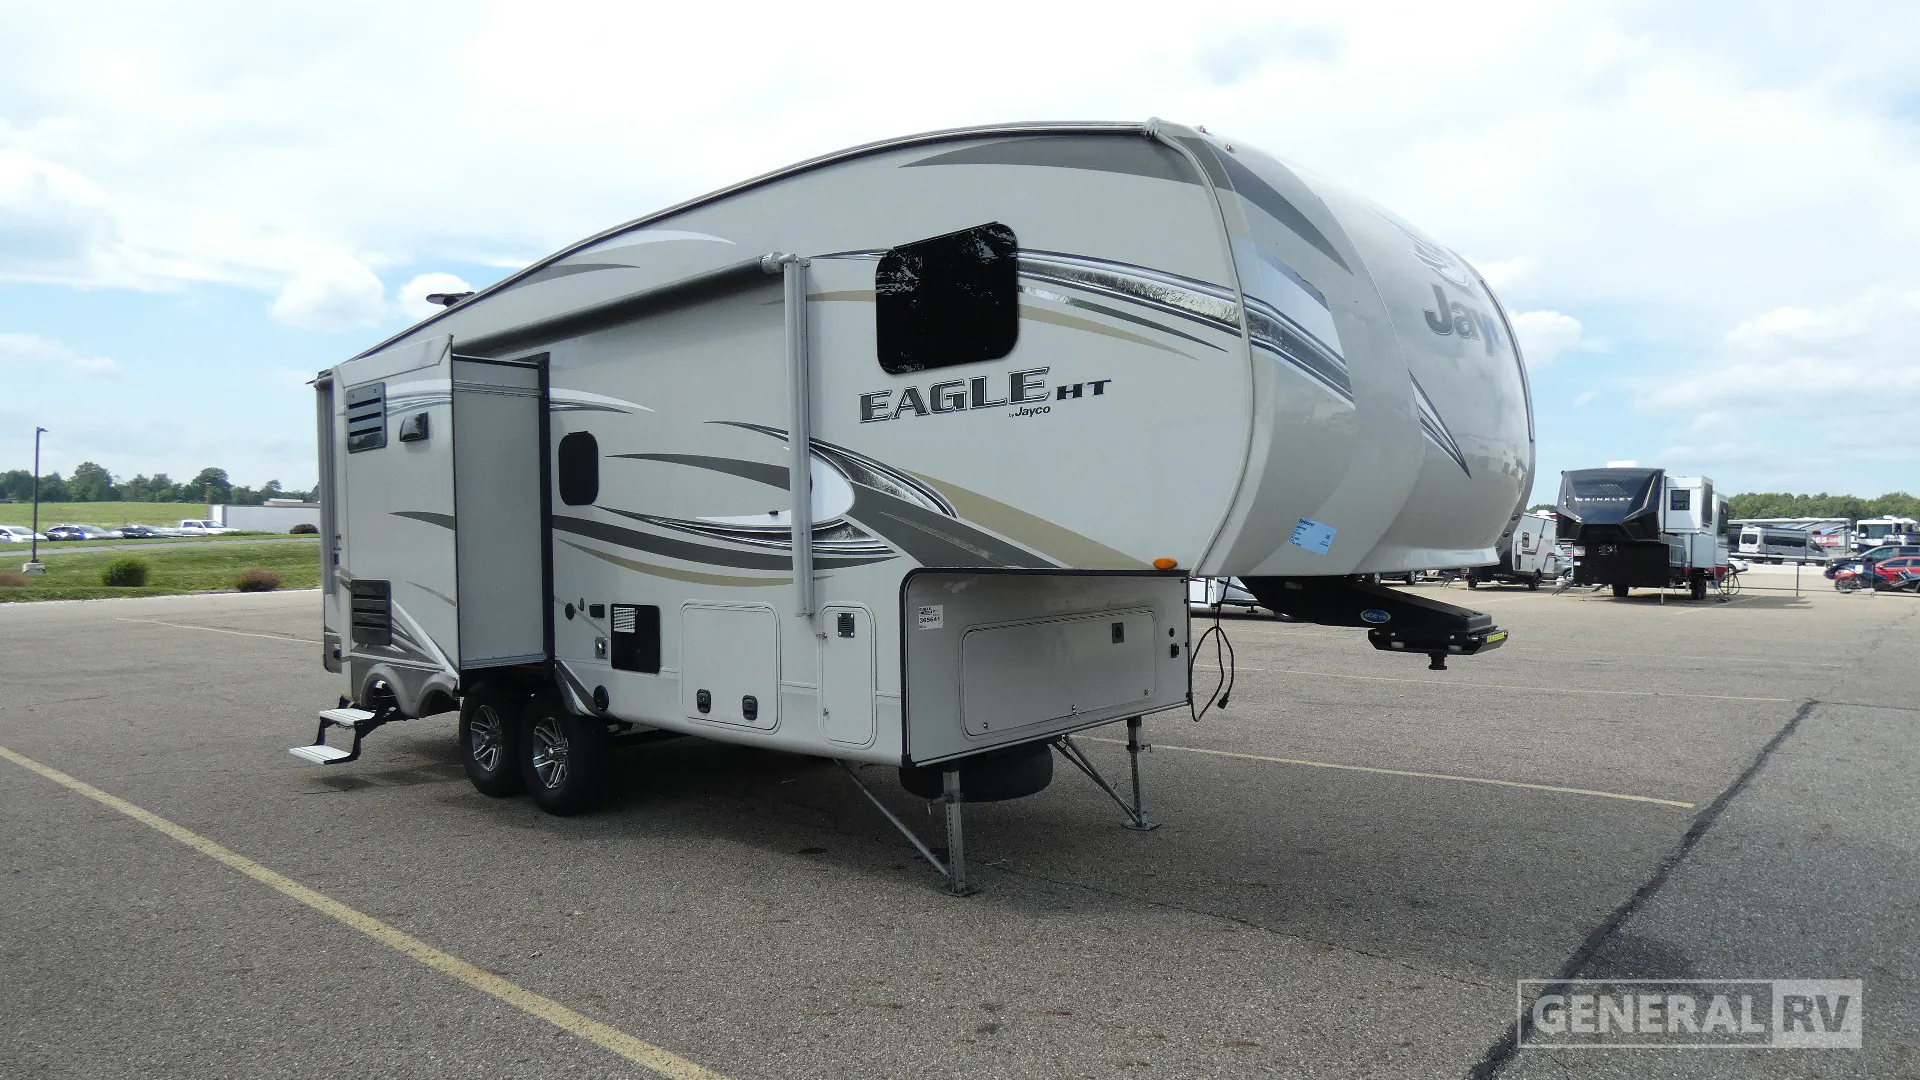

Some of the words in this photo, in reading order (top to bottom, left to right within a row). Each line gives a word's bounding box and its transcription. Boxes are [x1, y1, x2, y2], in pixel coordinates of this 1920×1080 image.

[859, 366, 1050, 423] EAGLE
[1056, 379, 1112, 400] HT
[1015, 405, 1051, 417] Jayco
